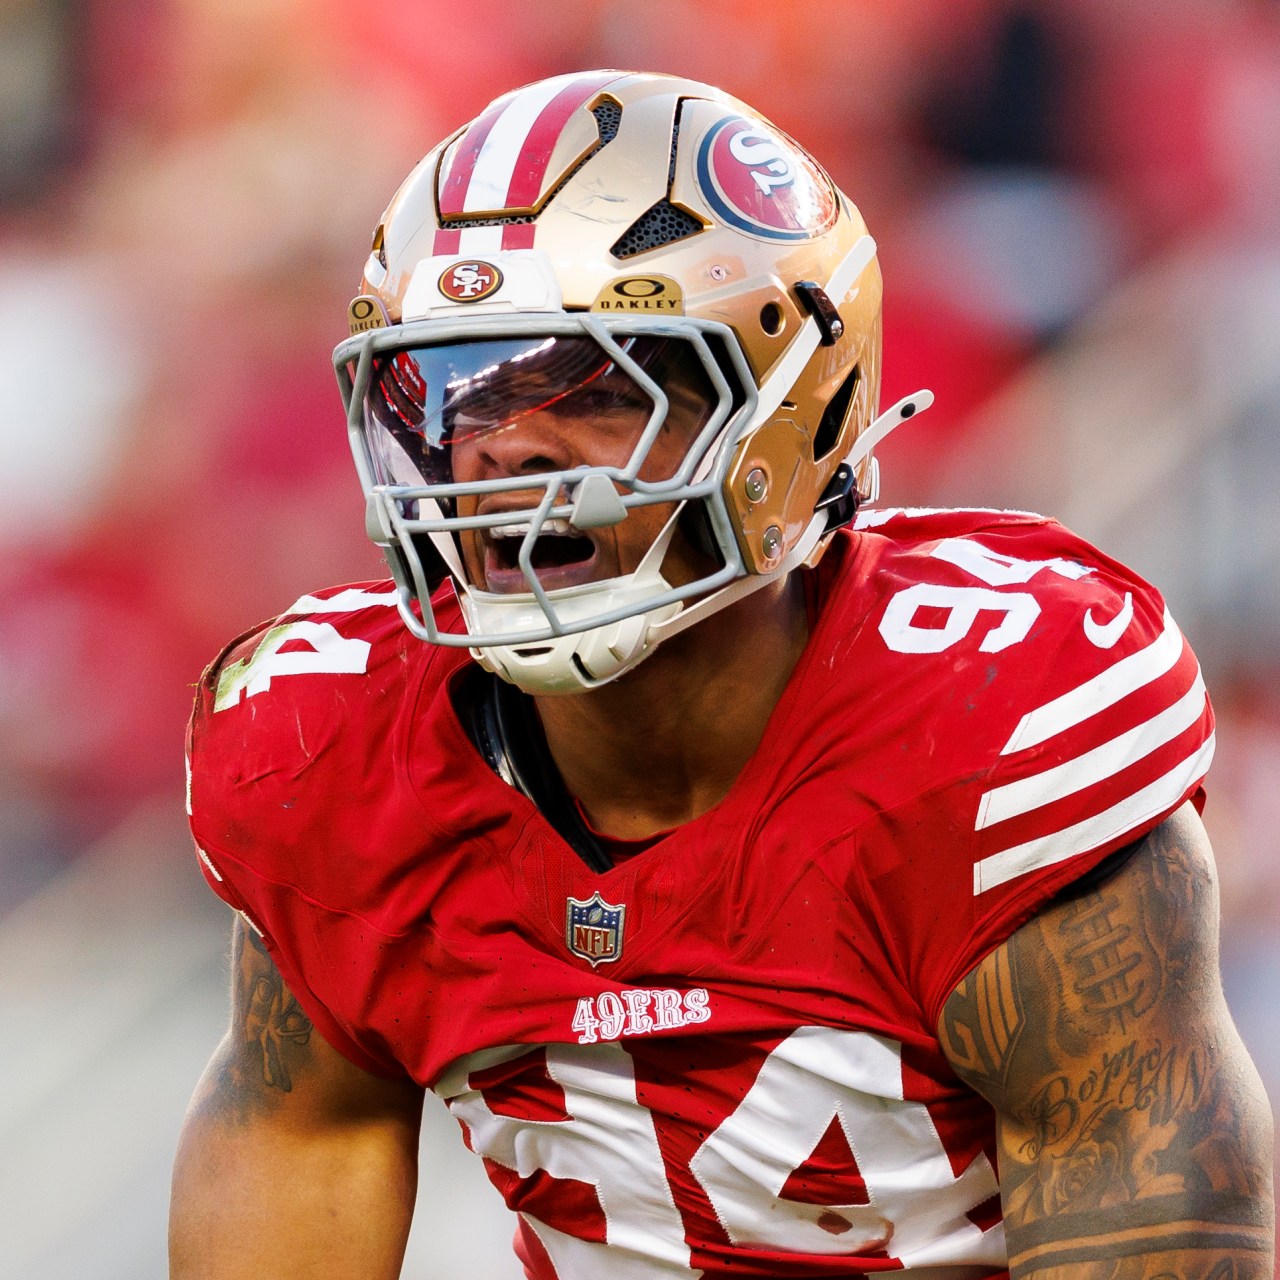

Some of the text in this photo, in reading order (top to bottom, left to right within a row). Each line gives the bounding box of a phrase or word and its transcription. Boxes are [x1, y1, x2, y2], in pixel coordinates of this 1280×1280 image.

[453, 264, 490, 297] SF
[600, 299, 678, 310] OAKLEY
[350, 319, 381, 334] OAKLEY
[878, 537, 1098, 655] 94
[574, 926, 614, 955] NFL
[572, 988, 712, 1045] 49ERS
